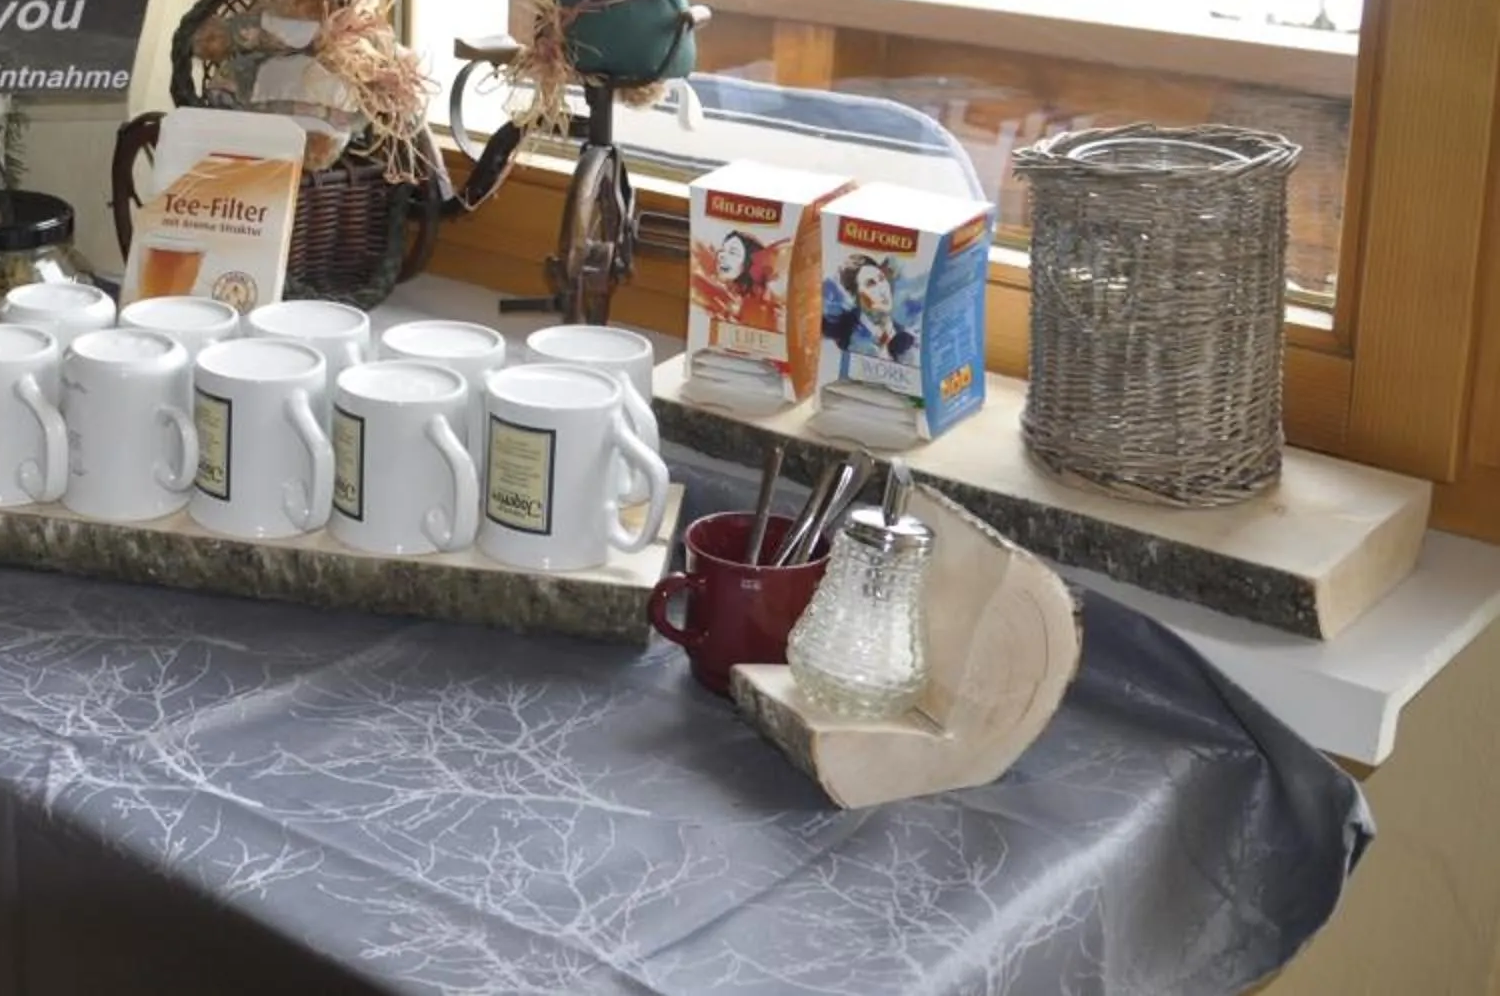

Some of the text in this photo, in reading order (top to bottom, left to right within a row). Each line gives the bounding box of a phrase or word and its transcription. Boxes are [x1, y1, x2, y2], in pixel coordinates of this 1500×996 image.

[163, 192, 268, 223] Tee-Filter
[711, 194, 778, 221] MILFORD
[845, 220, 913, 250] MILFORD
